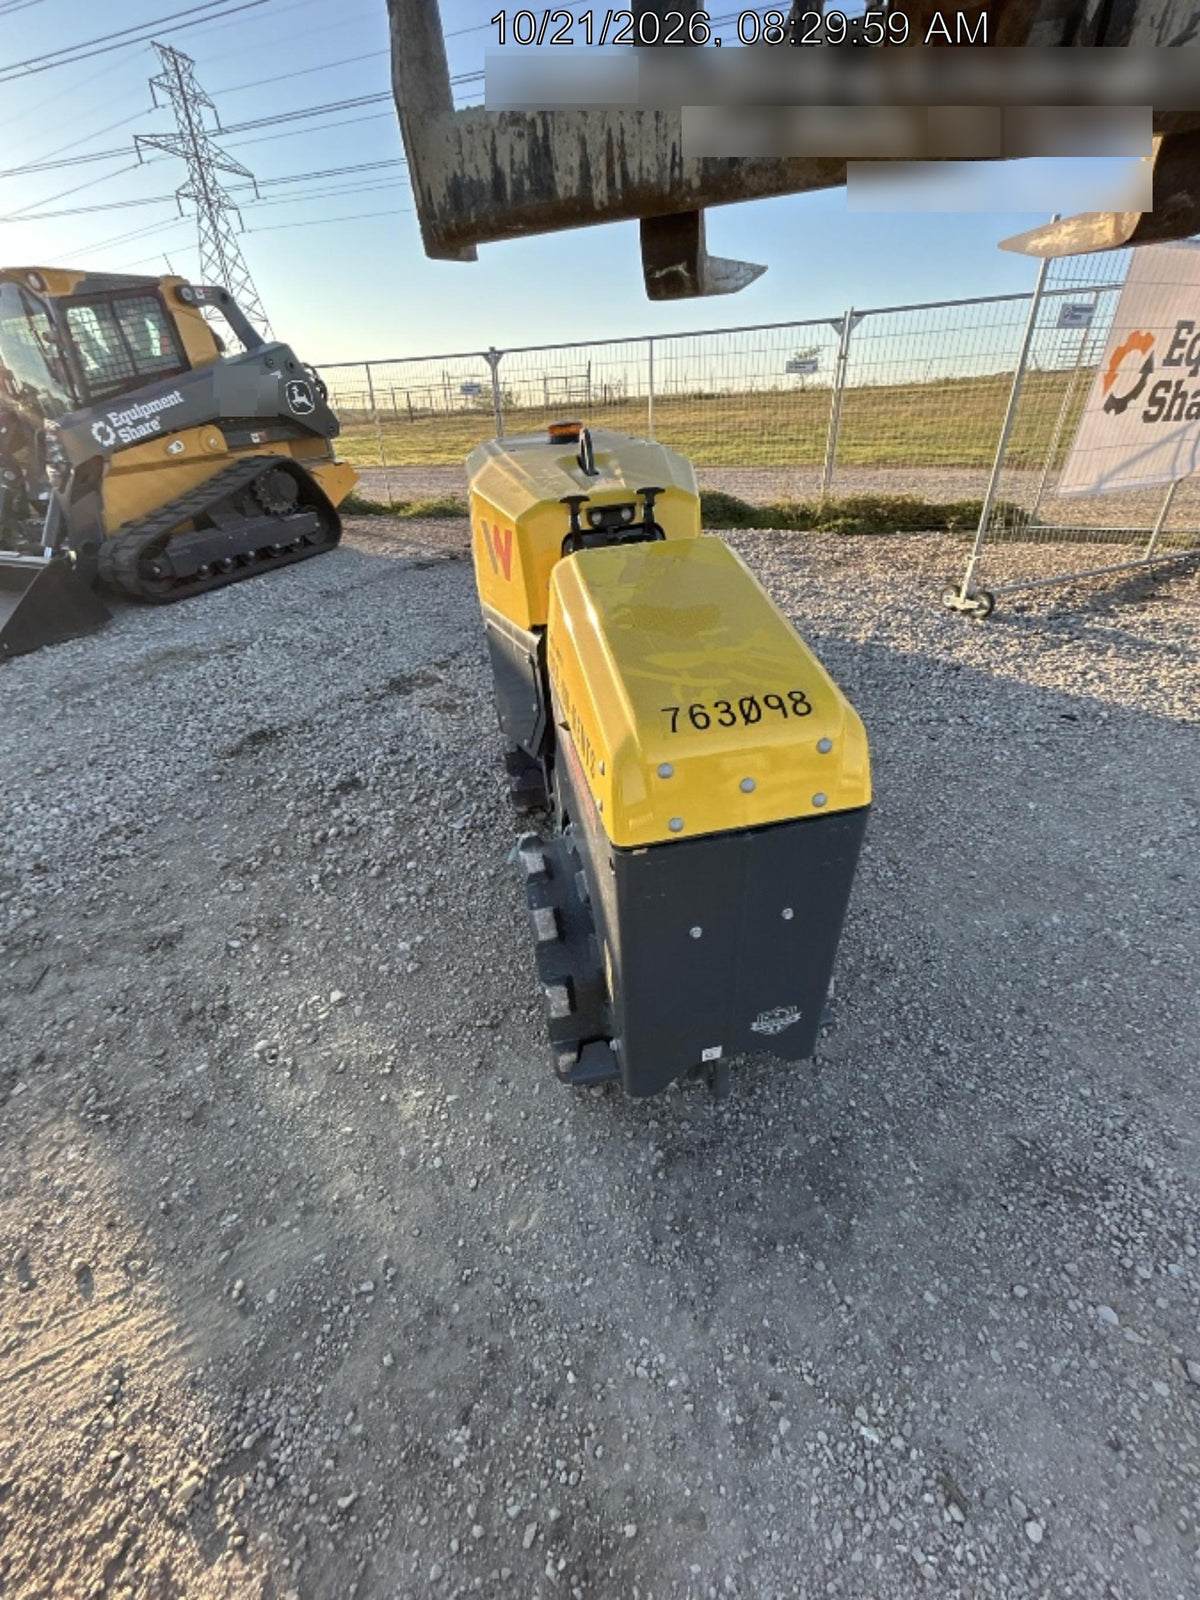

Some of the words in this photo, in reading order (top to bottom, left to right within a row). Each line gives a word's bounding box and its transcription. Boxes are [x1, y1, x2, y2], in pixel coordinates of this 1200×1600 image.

[106, 390, 184, 428] Equipment
[117, 418, 161, 443] Share
[660, 690, 813, 733] 763098
